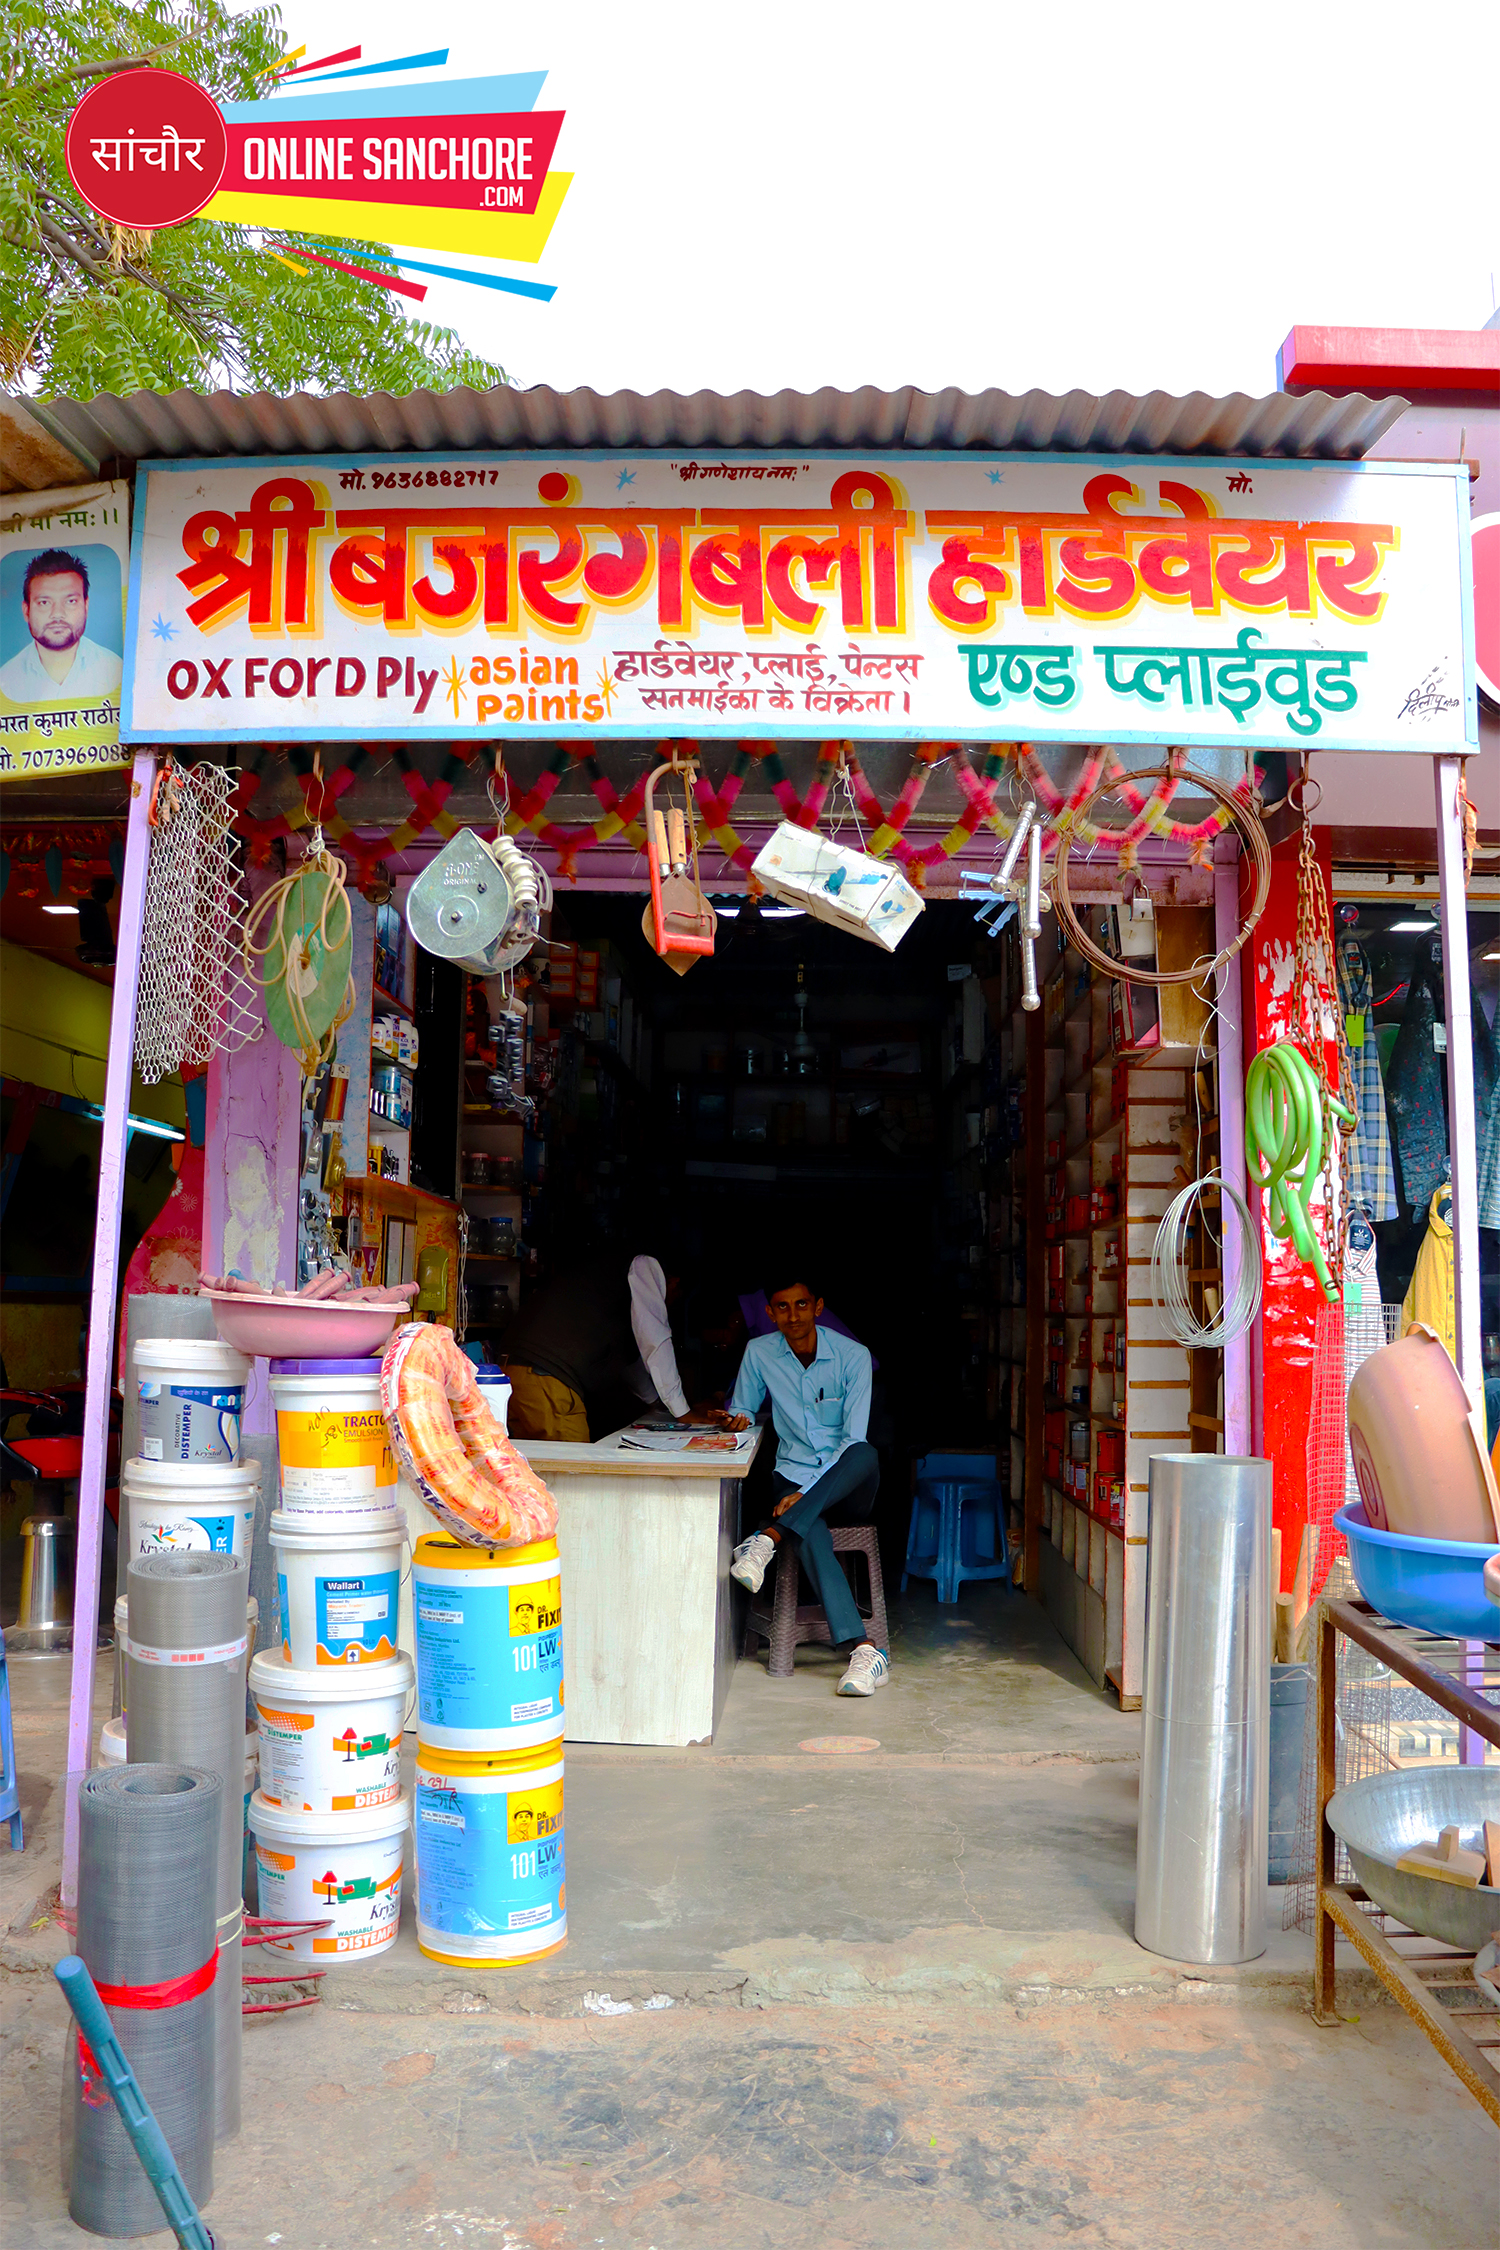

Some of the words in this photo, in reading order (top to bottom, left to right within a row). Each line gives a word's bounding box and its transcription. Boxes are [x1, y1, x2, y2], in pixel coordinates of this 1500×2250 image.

[338, 468, 366, 491] मो.
[371, 469, 499, 490] 9636882717
[1225, 471, 1254, 494] मो.
[176, 477, 330, 632] श्री
[926, 473, 1394, 626] हार्डवेयर
[470, 647, 580, 686] asian
[958, 644, 1077, 708] एण्ड
[1094, 627, 1369, 736] प्लाईवुड
[477, 688, 605, 723] paints
[766, 682, 794, 711] के
[32, 710, 78, 737] कुमार
[21, 745, 131, 770] 7073969088
[181, 1403, 192, 1459] DISTEMPER
[343, 1428, 384, 1438] EMULSION
[327, 1581, 360, 1591] Wallart
[538, 1605, 548, 1614] DR.
[512, 1643, 537, 1673] 101
[267, 1728, 303, 1741] DISTEMPER
[356, 1782, 387, 1794] WASHABLE
[537, 1811, 549, 1820] DR.
[510, 1850, 536, 1880] 101
[337, 1925, 374, 1937] WASHABLE
